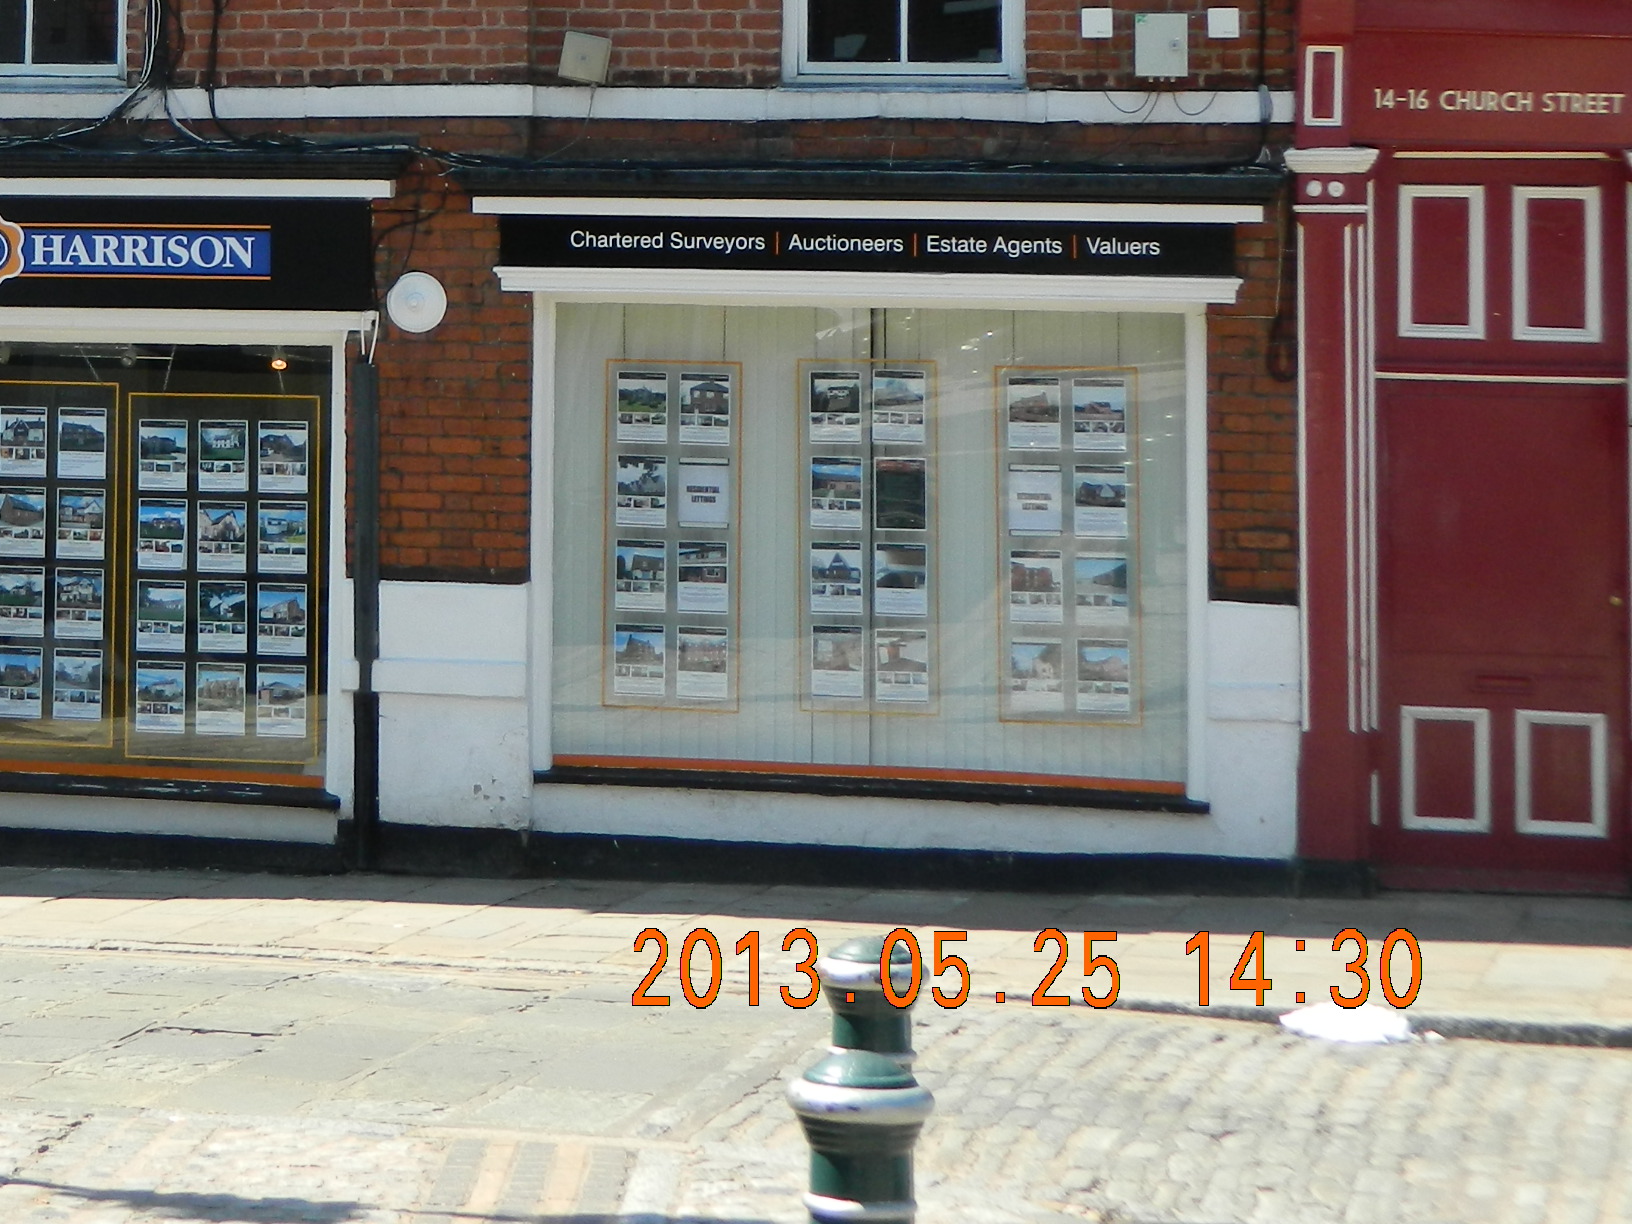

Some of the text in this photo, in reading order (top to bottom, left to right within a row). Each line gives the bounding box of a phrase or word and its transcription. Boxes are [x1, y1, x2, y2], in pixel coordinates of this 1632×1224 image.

[1374, 88, 1625, 114] 14-16 CHURCH STREET
[32, 235, 255, 269] HARRISON
[570, 230, 1161, 258] Chartered Surveyors Auctioneers Estate Agents Valuers
